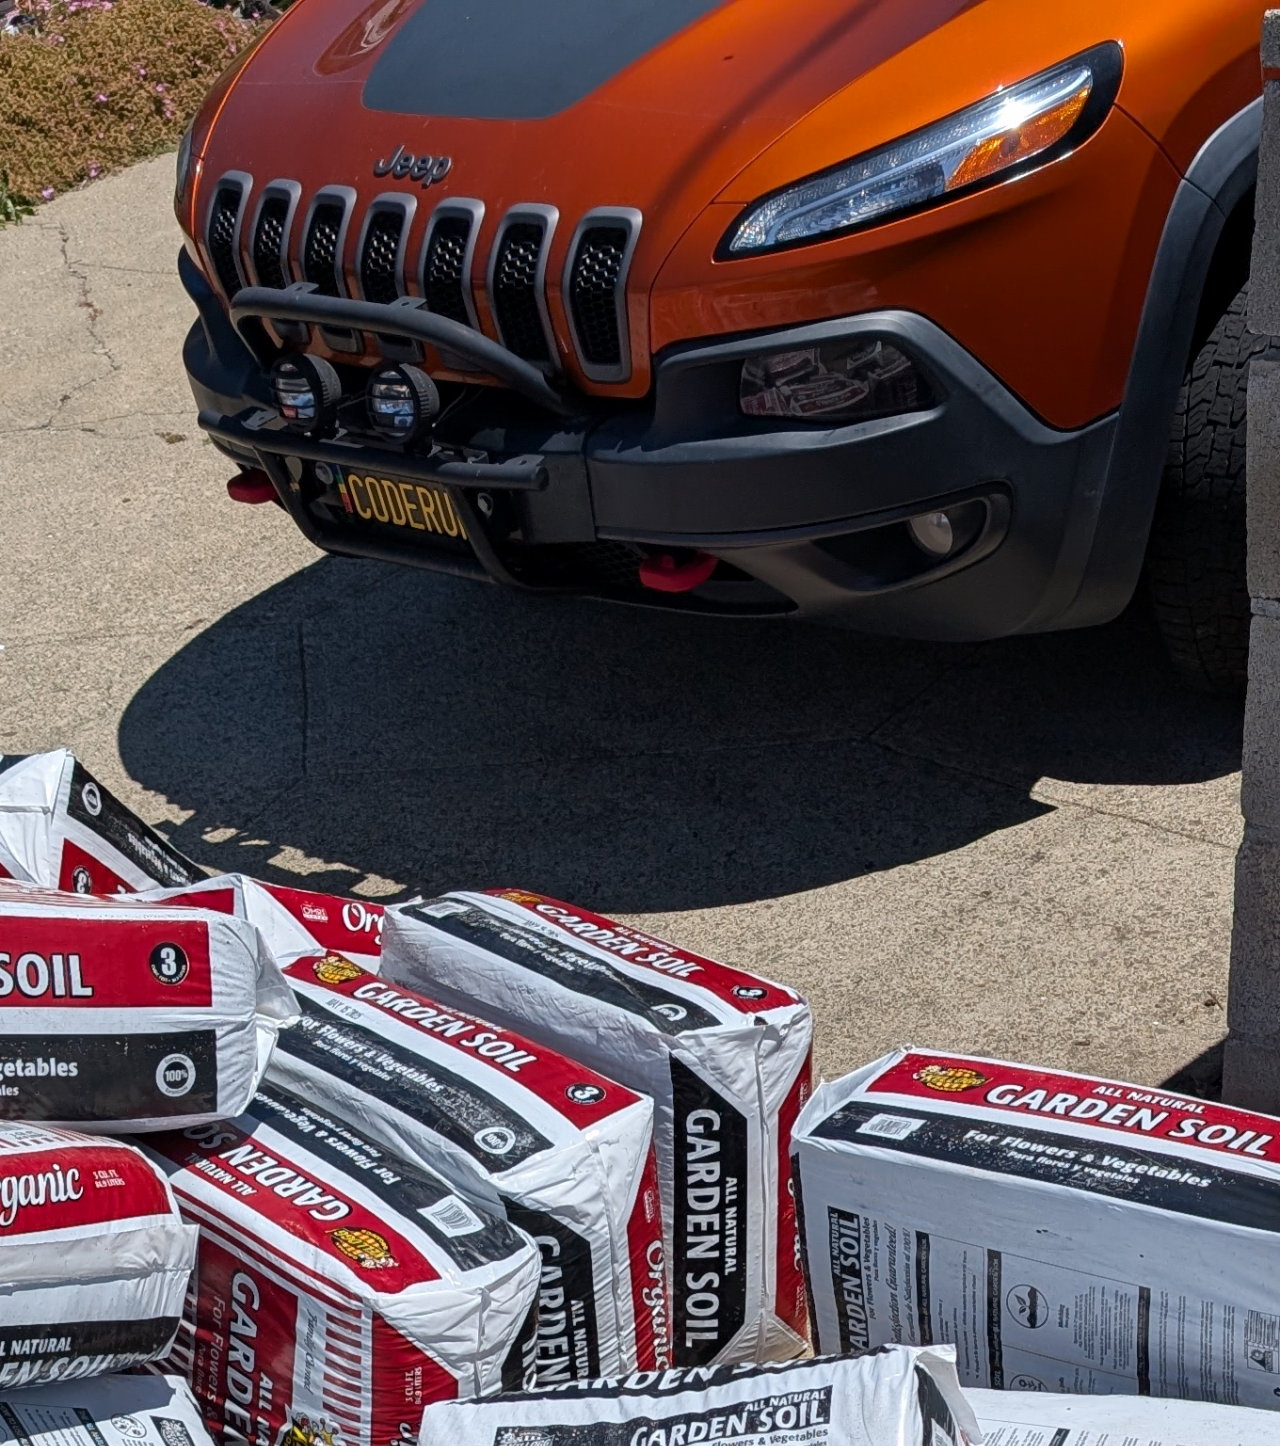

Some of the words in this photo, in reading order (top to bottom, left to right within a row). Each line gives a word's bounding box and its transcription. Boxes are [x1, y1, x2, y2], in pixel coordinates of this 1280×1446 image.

[373, 144, 451, 189] Jeep
[348, 474, 468, 541] CODERU
[534, 904, 641, 955] GARDEN
[635, 951, 705, 977] SOIL
[353, 981, 472, 1038] GARDEN
[460, 1032, 538, 1073] SOIL
[986, 1083, 1170, 1131] GARDEN
[1168, 1117, 1273, 1157] SOIL
[1093, 1083, 1122, 1098] ALL
[1126, 1090, 1205, 1115] NATURAL
[685, 1109, 721, 1259] GARDEN
[963, 1129, 995, 1145] For
[999, 1135, 1079, 1161] Flowers
[1081, 1152, 1096, 1164] &
[1099, 1154, 1212, 1189] Vegetables
[725, 1177, 737, 1204] ALL
[724, 1207, 737, 1276] NATURAL
[839, 1217, 861, 1270] SOIL
[535, 1235, 572, 1389] GARDEN
[685, 1273, 720, 1348] SOIL
[842, 1274, 870, 1352] ARDEN
[10, 1337, 71, 1355] NATURAL
[259, 1372, 273, 1411] ALL
[744, 1399, 767, 1412] ALL
[769, 1390, 826, 1407] NATURAL
[758, 1402, 825, 1432] SOIL
[758, 1436, 767, 1445] &
[769, 1428, 829, 1446] Vegetables
